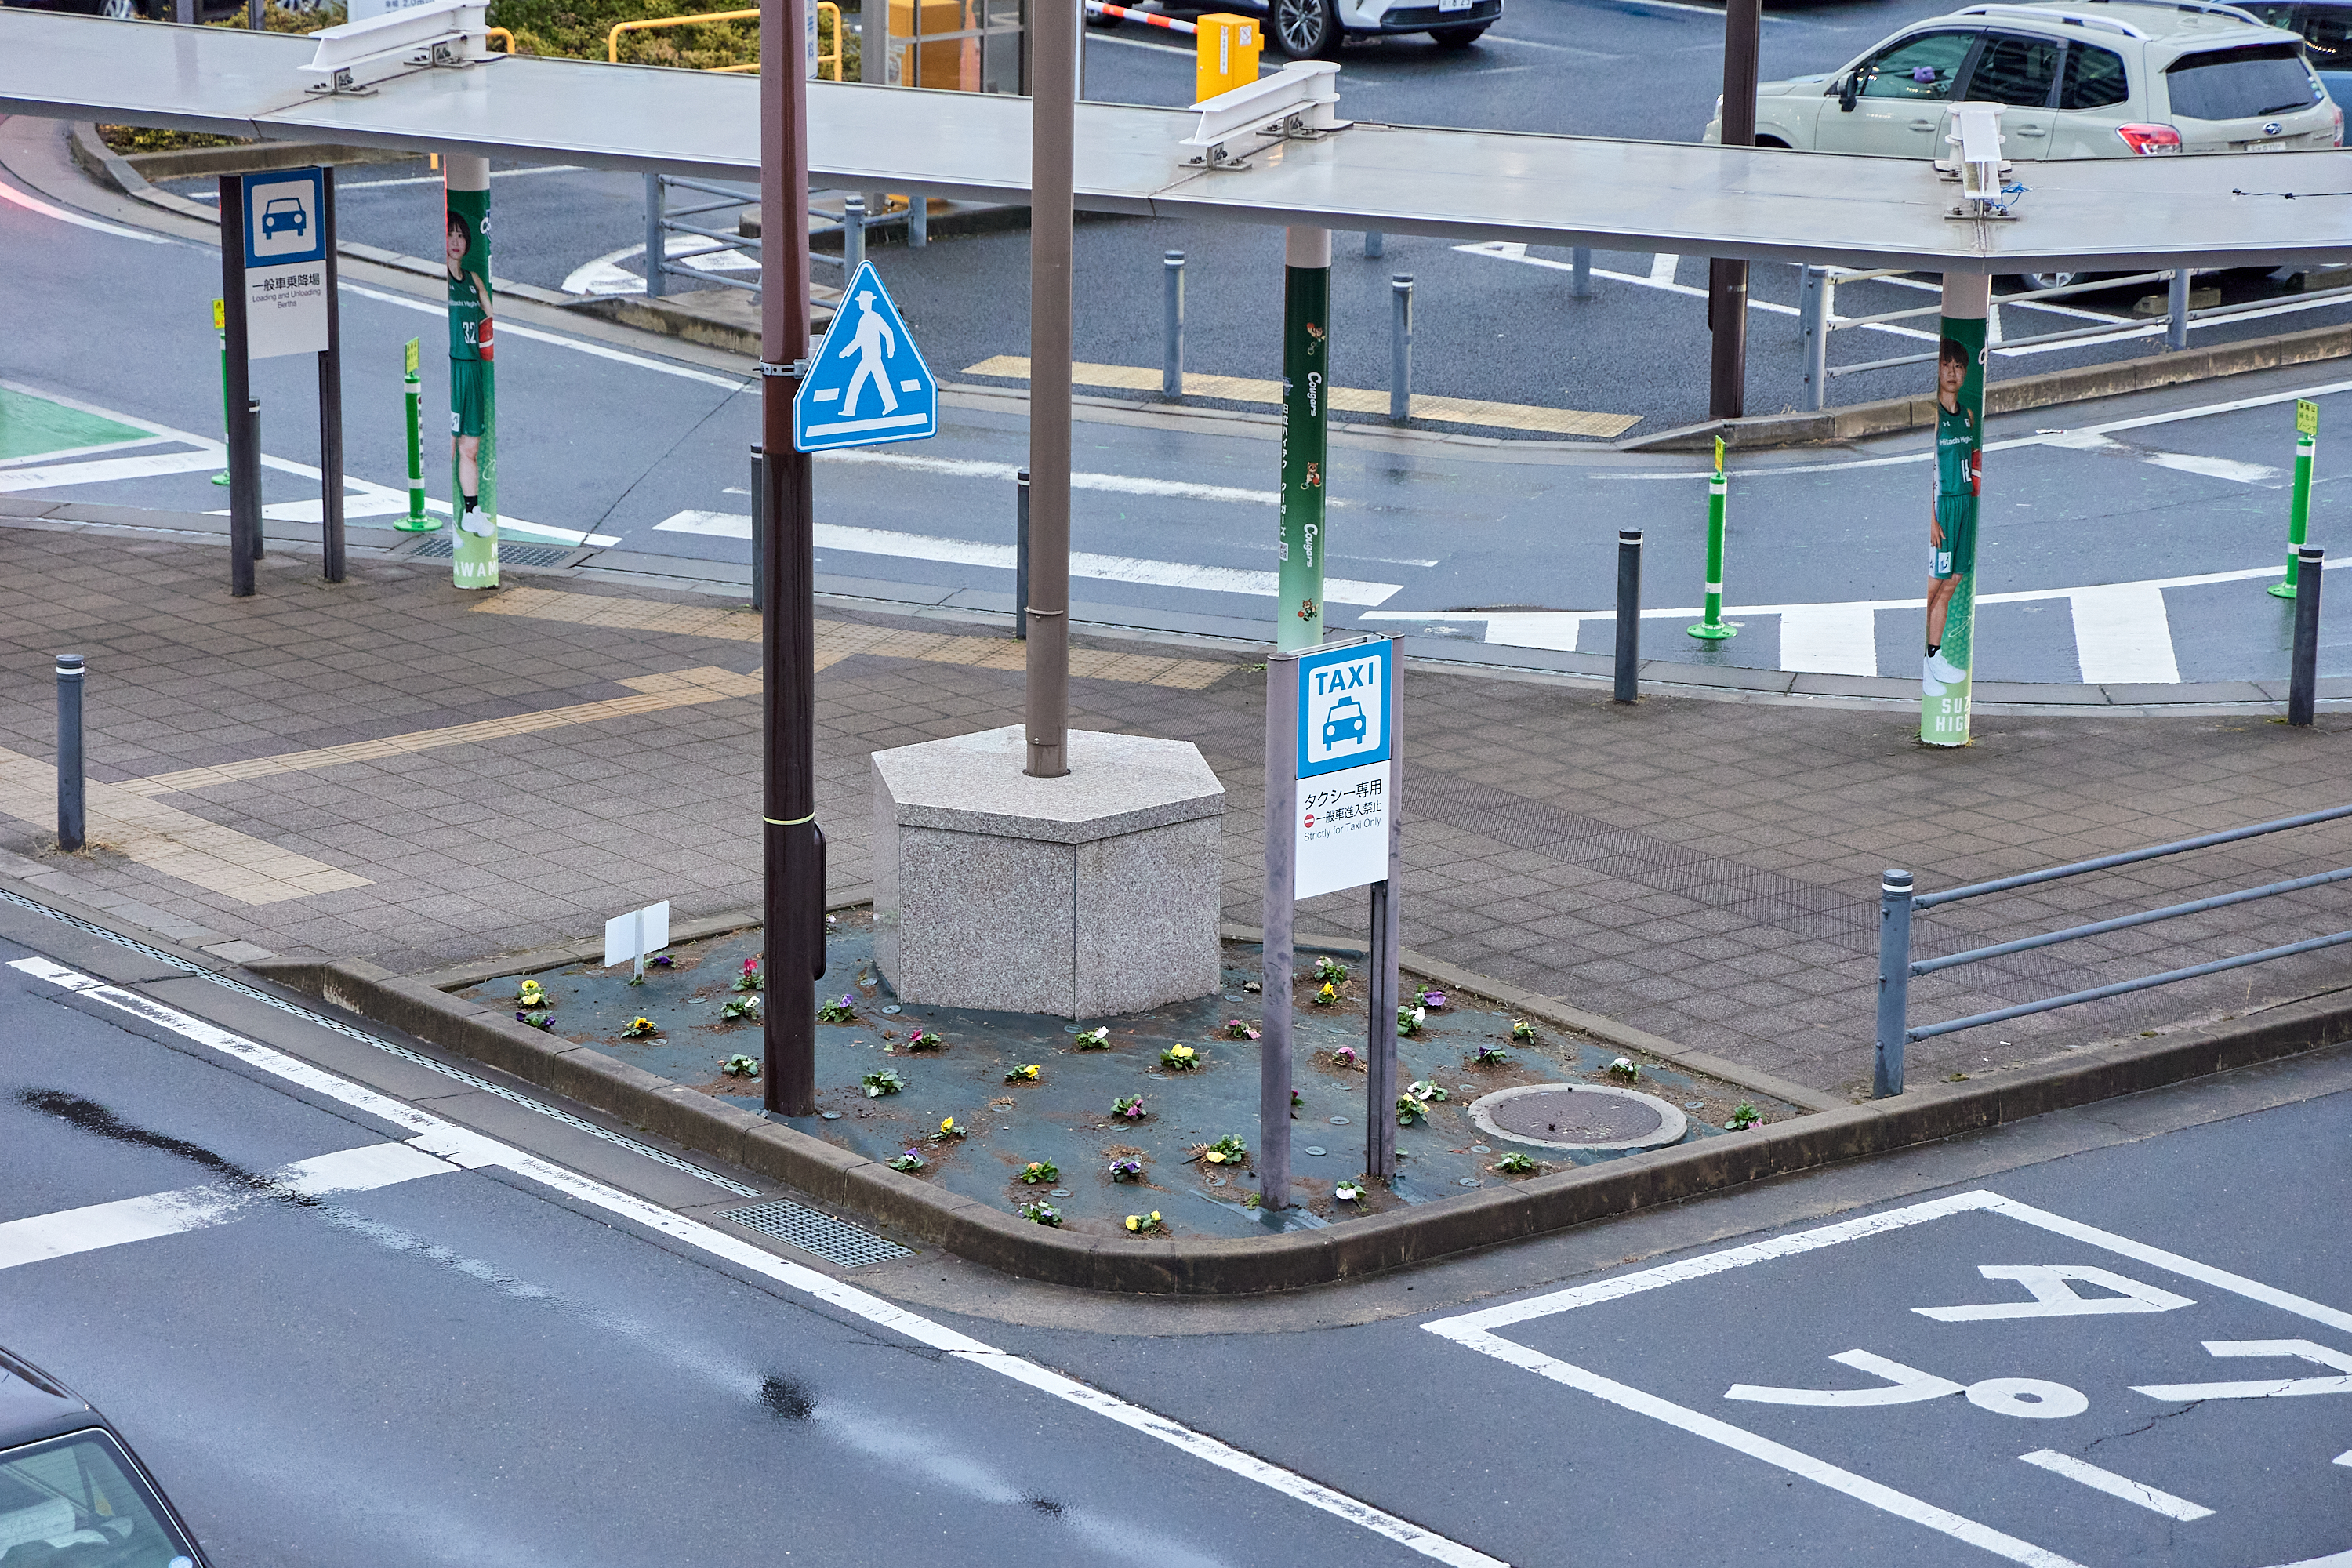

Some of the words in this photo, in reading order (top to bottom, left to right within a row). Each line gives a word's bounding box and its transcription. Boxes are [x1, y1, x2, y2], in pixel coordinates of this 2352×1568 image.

[252, 273, 320, 291] 一般車乗降場
[252, 293, 277, 303] Loading
[278, 291, 289, 299] and
[291, 289, 321, 298] Unloading
[277, 300, 297, 309] Berths
[463, 321, 477, 344] 32
[1307, 372, 1323, 417] Cougars
[1939, 437, 1960, 446] Hitachi
[1303, 523, 1318, 568] Cougars
[1316, 662, 1374, 695] TAXI
[1305, 779, 1381, 811] タクシー専用
[1316, 800, 1381, 823] 一般車進入禁止
[1304, 828, 1331, 841] Strictly
[1333, 826, 1344, 835] for
[1345, 820, 1362, 832] Taxi
[1363, 817, 1381, 828] Only
